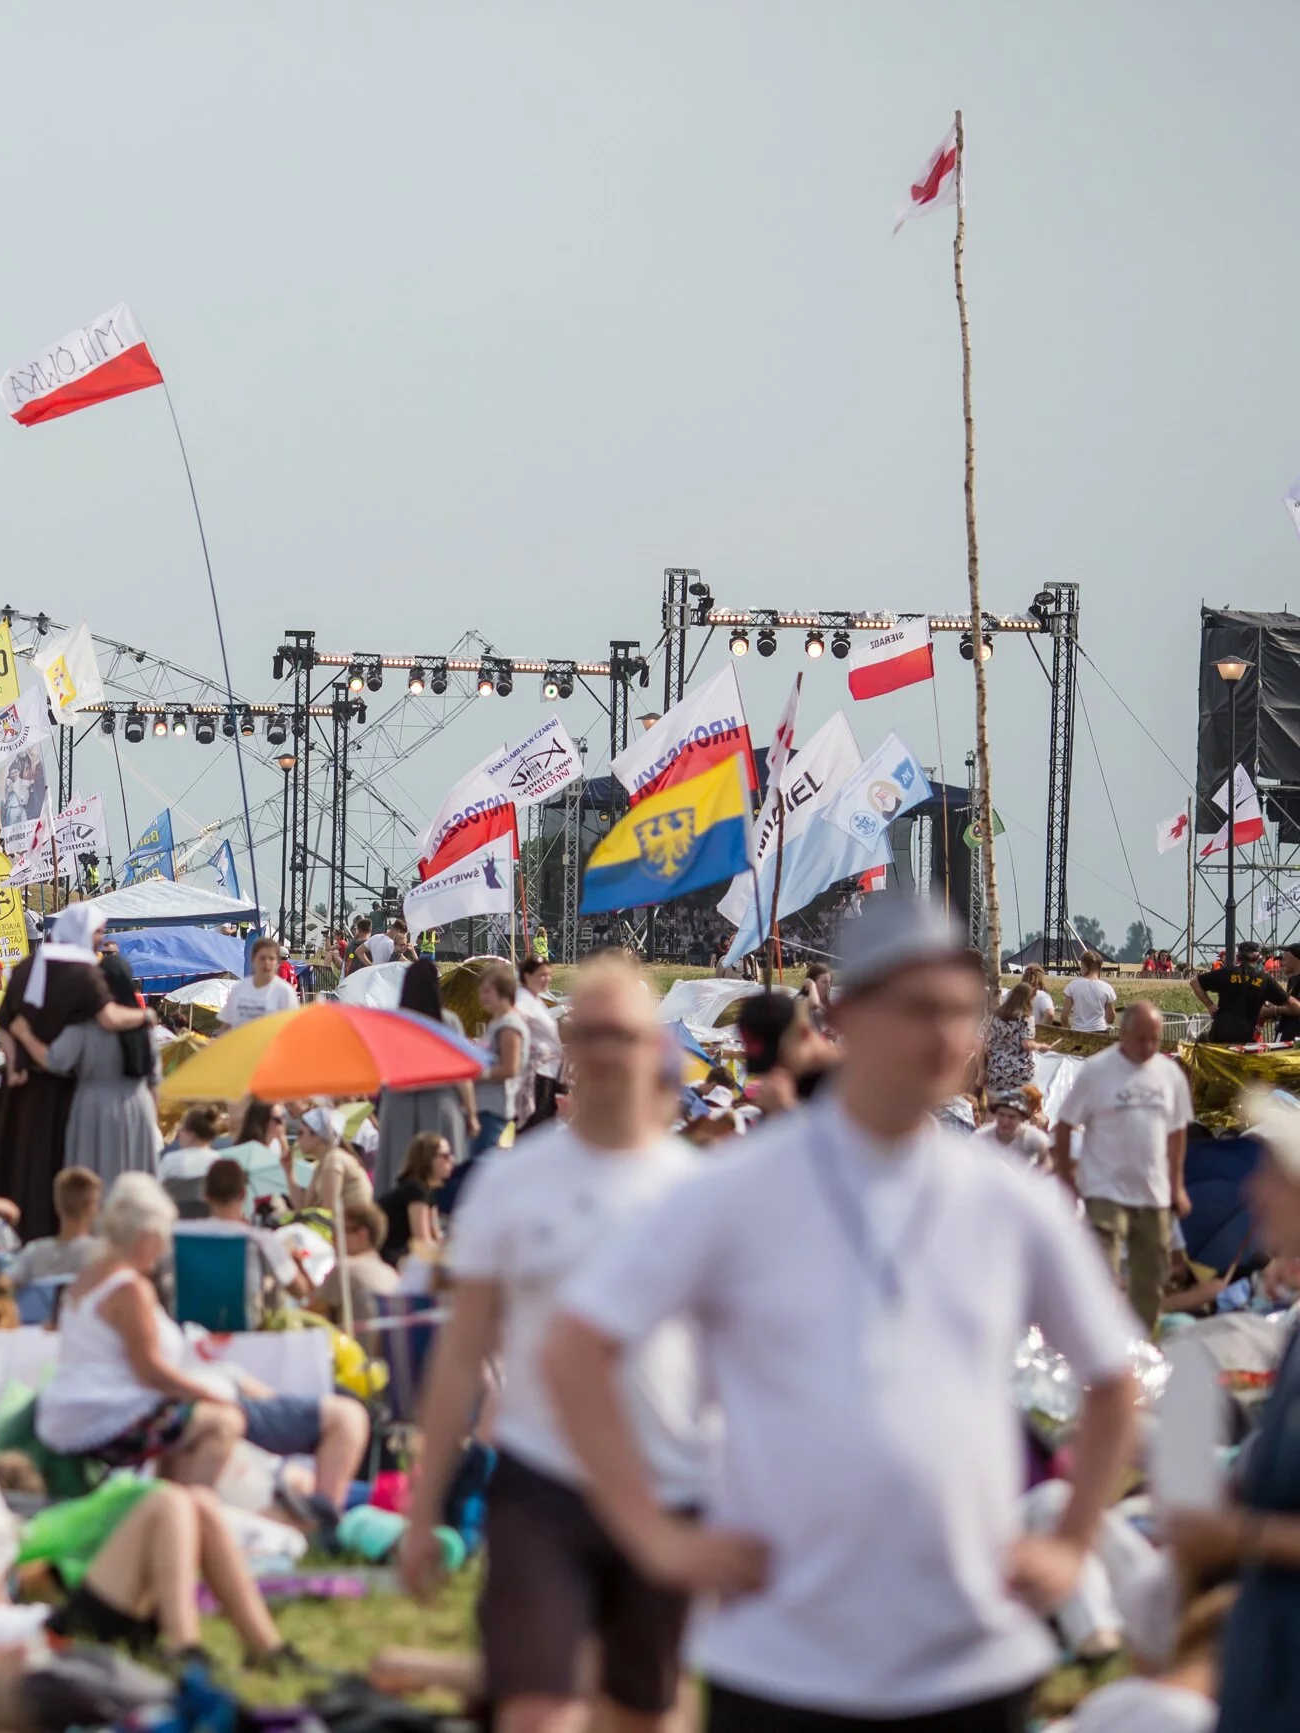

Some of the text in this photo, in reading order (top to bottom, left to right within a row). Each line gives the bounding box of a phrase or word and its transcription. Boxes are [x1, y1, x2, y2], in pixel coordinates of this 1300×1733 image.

[487, 718, 559, 776] SANKTUARIUM W CZARNEJ
[554, 756, 573, 774] 2000
[529, 768, 571, 798] PALLOTYNI
